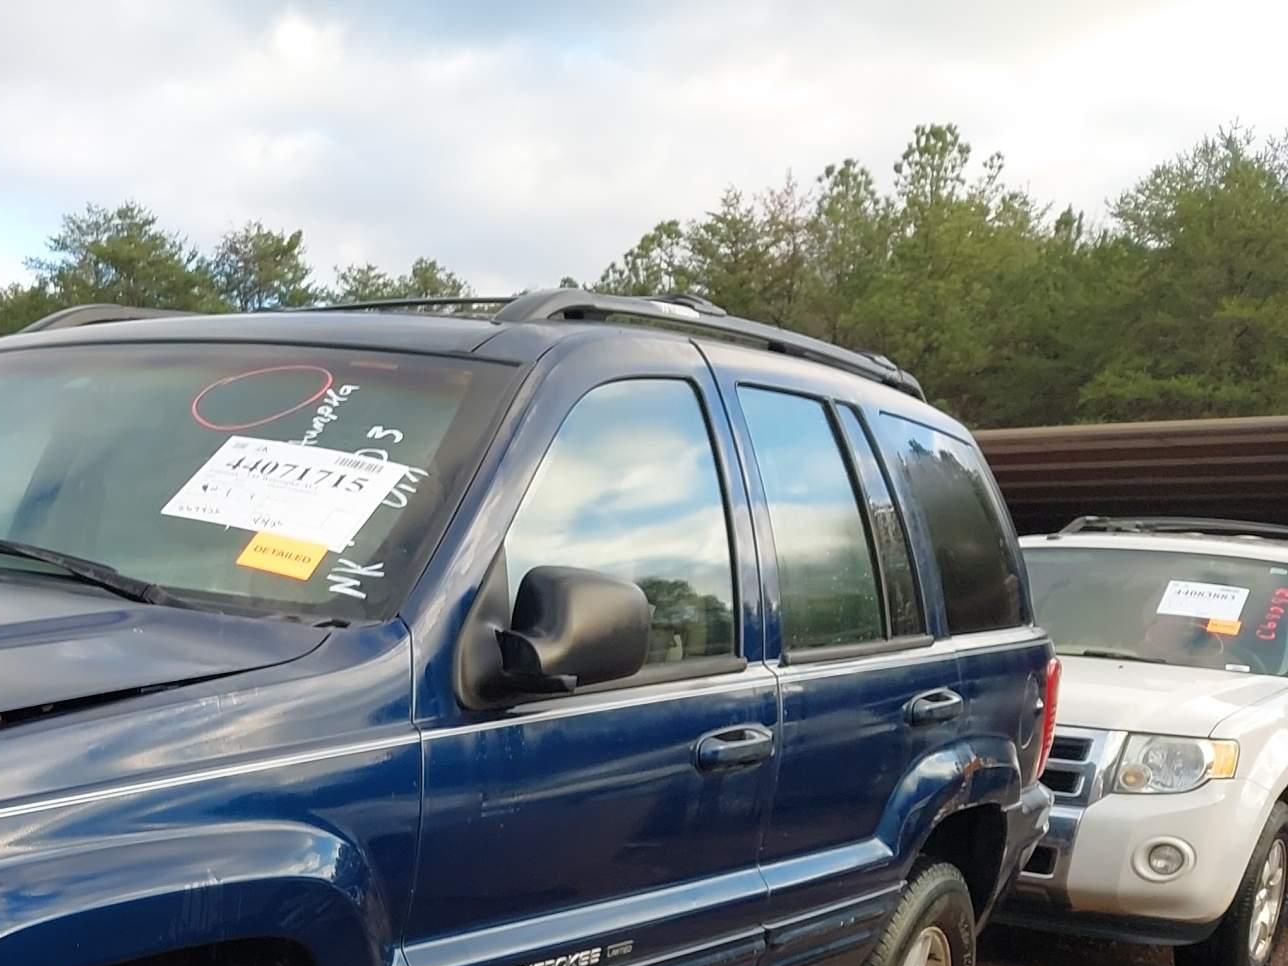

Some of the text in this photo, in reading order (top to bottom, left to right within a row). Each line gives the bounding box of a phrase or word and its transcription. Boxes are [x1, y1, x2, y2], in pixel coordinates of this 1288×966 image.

[225, 455, 369, 493] 44071715
[253, 545, 312, 565] DETAILED
[326, 558, 385, 599] NK
